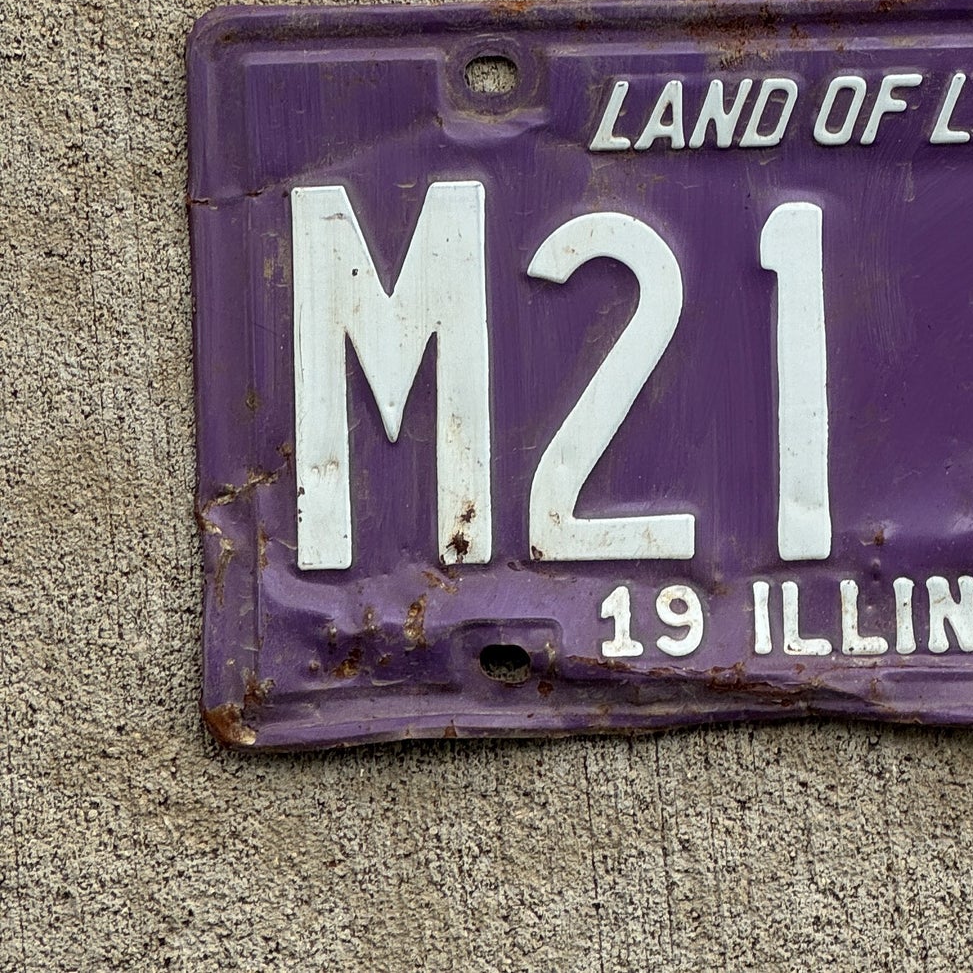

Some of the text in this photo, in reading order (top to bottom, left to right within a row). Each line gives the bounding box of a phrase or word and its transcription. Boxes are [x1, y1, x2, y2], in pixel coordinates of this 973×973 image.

[588, 78, 800, 150] LAND
[812, 73, 924, 145] OF
[290, 181, 832, 570] M21
[600, 584, 705, 659] 19
